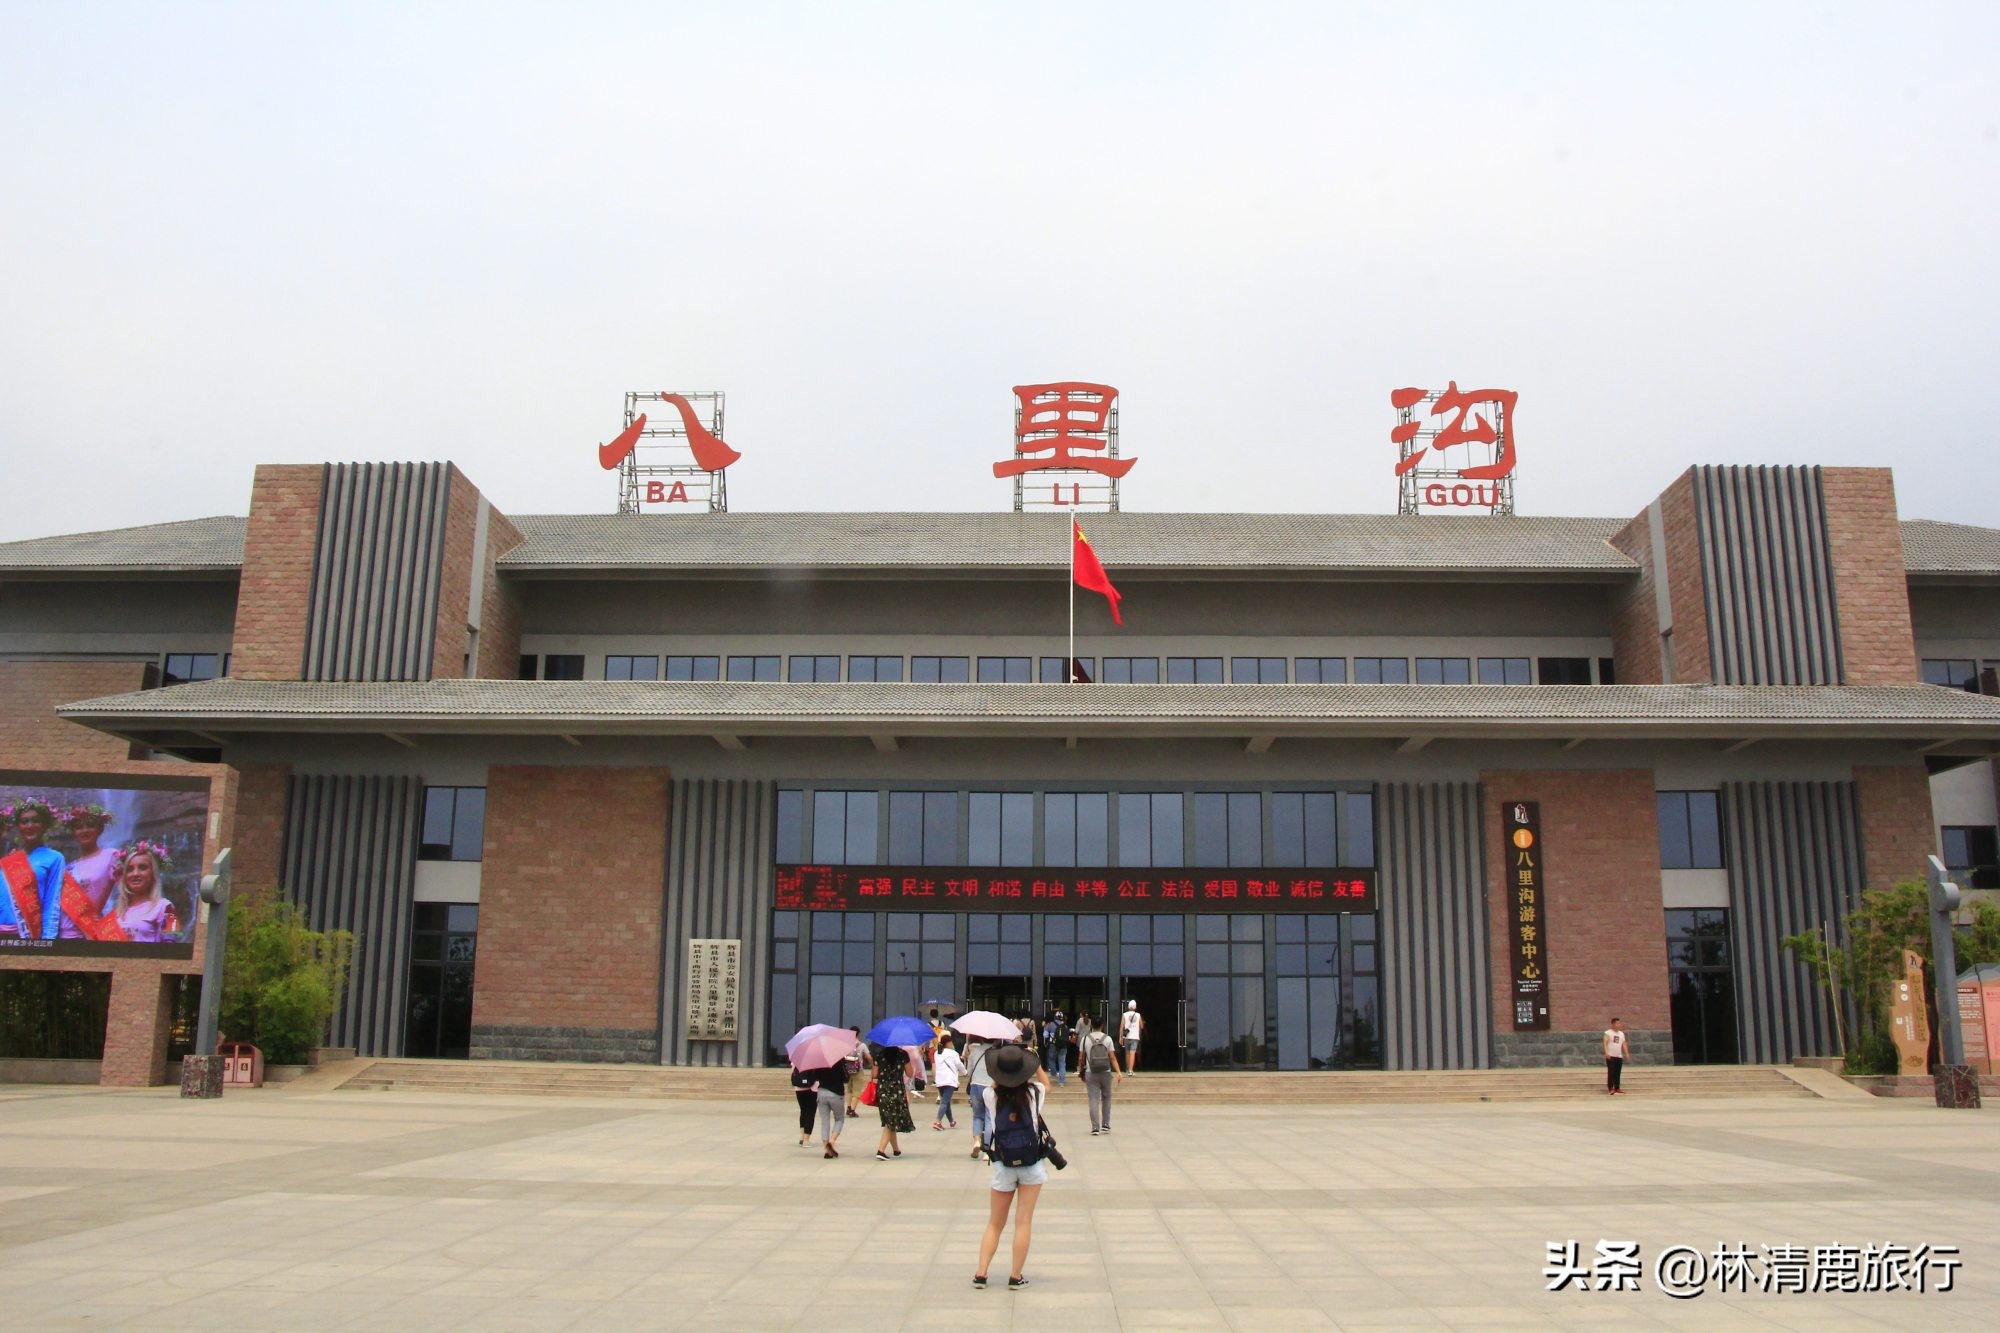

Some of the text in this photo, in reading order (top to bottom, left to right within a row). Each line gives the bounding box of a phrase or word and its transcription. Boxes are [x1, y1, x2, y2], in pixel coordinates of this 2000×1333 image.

[646, 480, 1500, 507] BA LI GOU
[858, 878, 893, 896] 富强
[902, 878, 935, 896] 民主
[945, 879, 979, 897] 文明
[988, 879, 1022, 898] 和谐
[1031, 880, 1065, 898] 自由
[1075, 880, 1109, 897] 平等
[1118, 880, 1151, 897] 公正
[1161, 880, 1195, 898] 法治
[1204, 880, 1238, 898] 爱国
[1247, 879, 1281, 898] 敬业
[1290, 879, 1324, 898] 诚信
[1333, 879, 1367, 898] 友善
[1516, 851, 1540, 979] 八里沟游客中心
